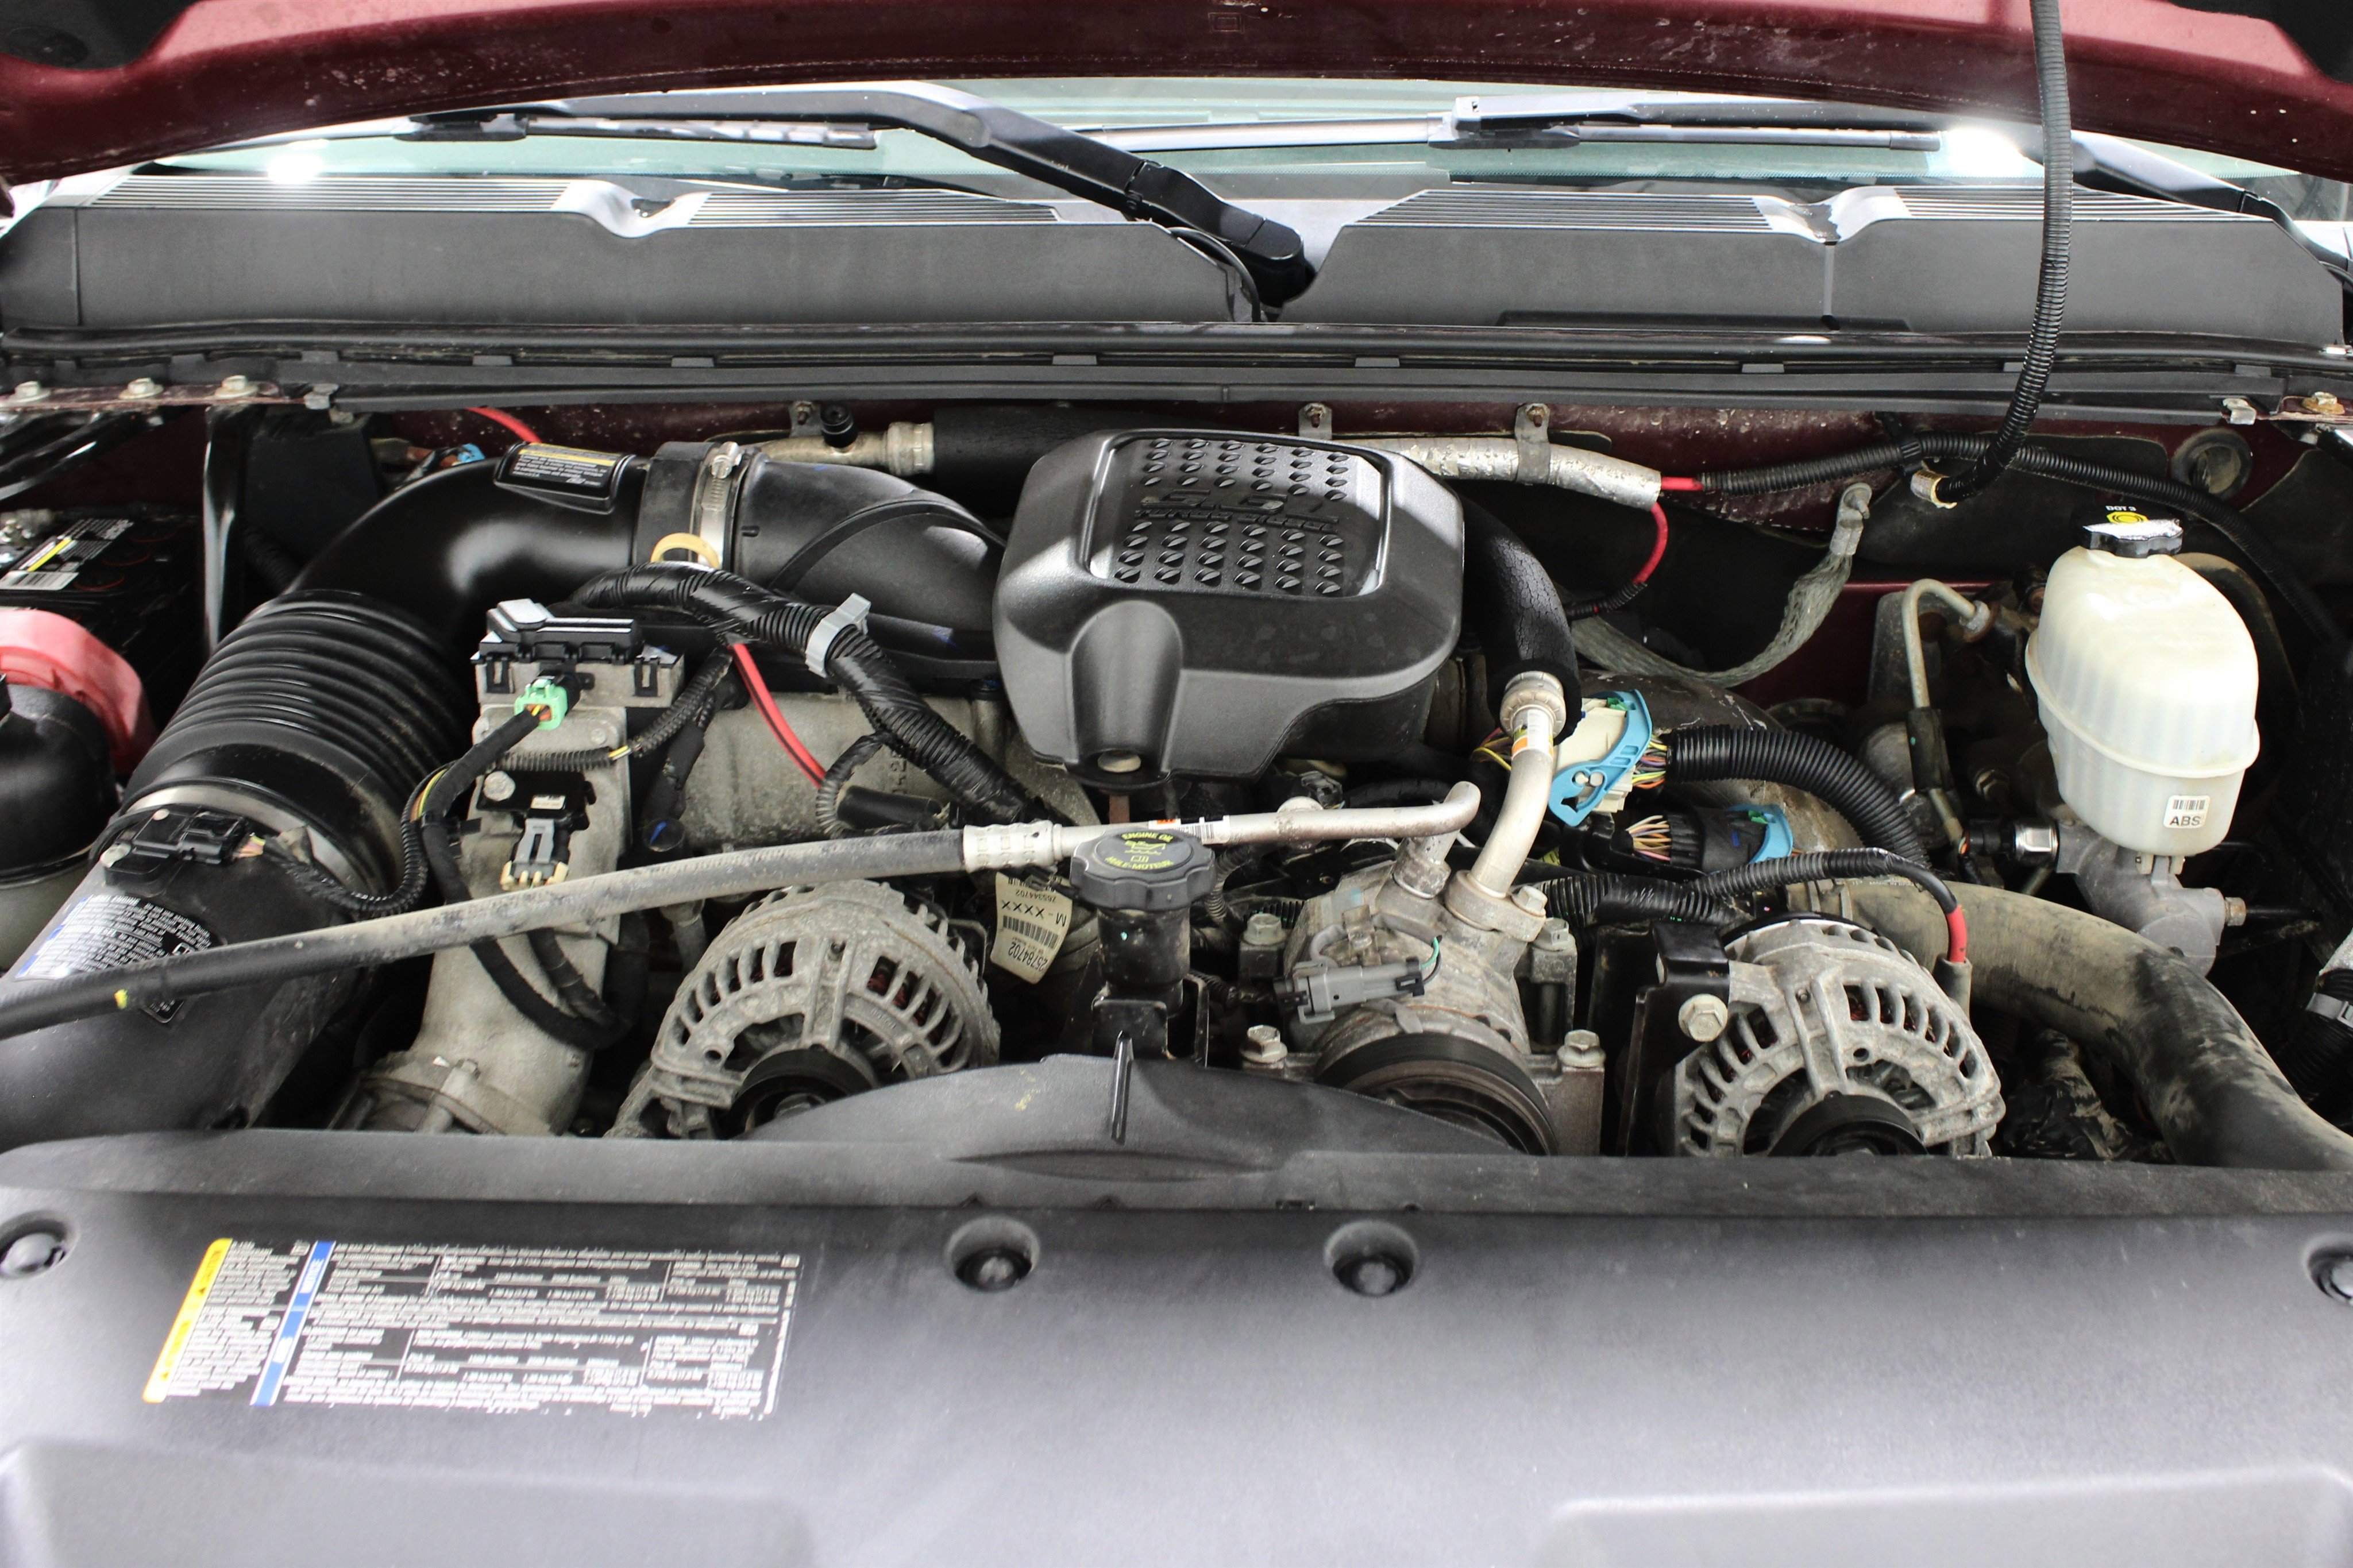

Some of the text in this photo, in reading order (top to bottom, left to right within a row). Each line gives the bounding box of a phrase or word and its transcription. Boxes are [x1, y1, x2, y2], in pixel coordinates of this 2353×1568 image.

[2169, 816, 2201, 826] ABS
[1121, 832, 1159, 840] ENGINE
[1008, 941, 1048, 972] 25784702
